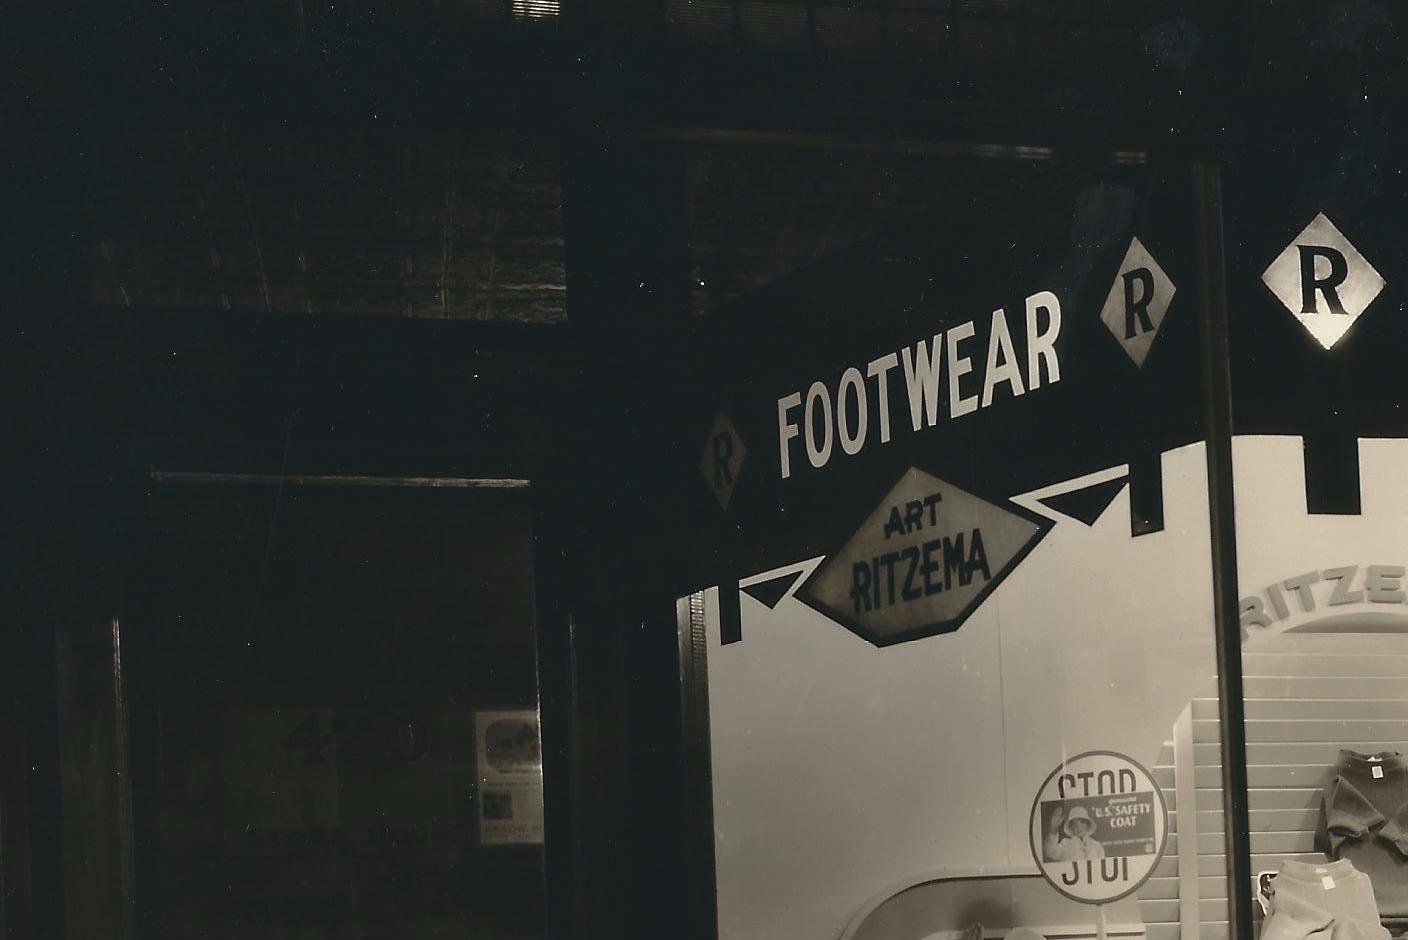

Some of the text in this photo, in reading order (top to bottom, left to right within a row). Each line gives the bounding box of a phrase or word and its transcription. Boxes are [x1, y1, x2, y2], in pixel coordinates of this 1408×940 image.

[1120, 266, 1156, 341] R
[1296, 243, 1350, 316] R
[776, 290, 1062, 479] FOOTWEAR
[712, 428, 735, 491] R
[883, 492, 943, 540] ART
[849, 527, 992, 615] RITZEMA
[1110, 816, 1137, 828] COAT
